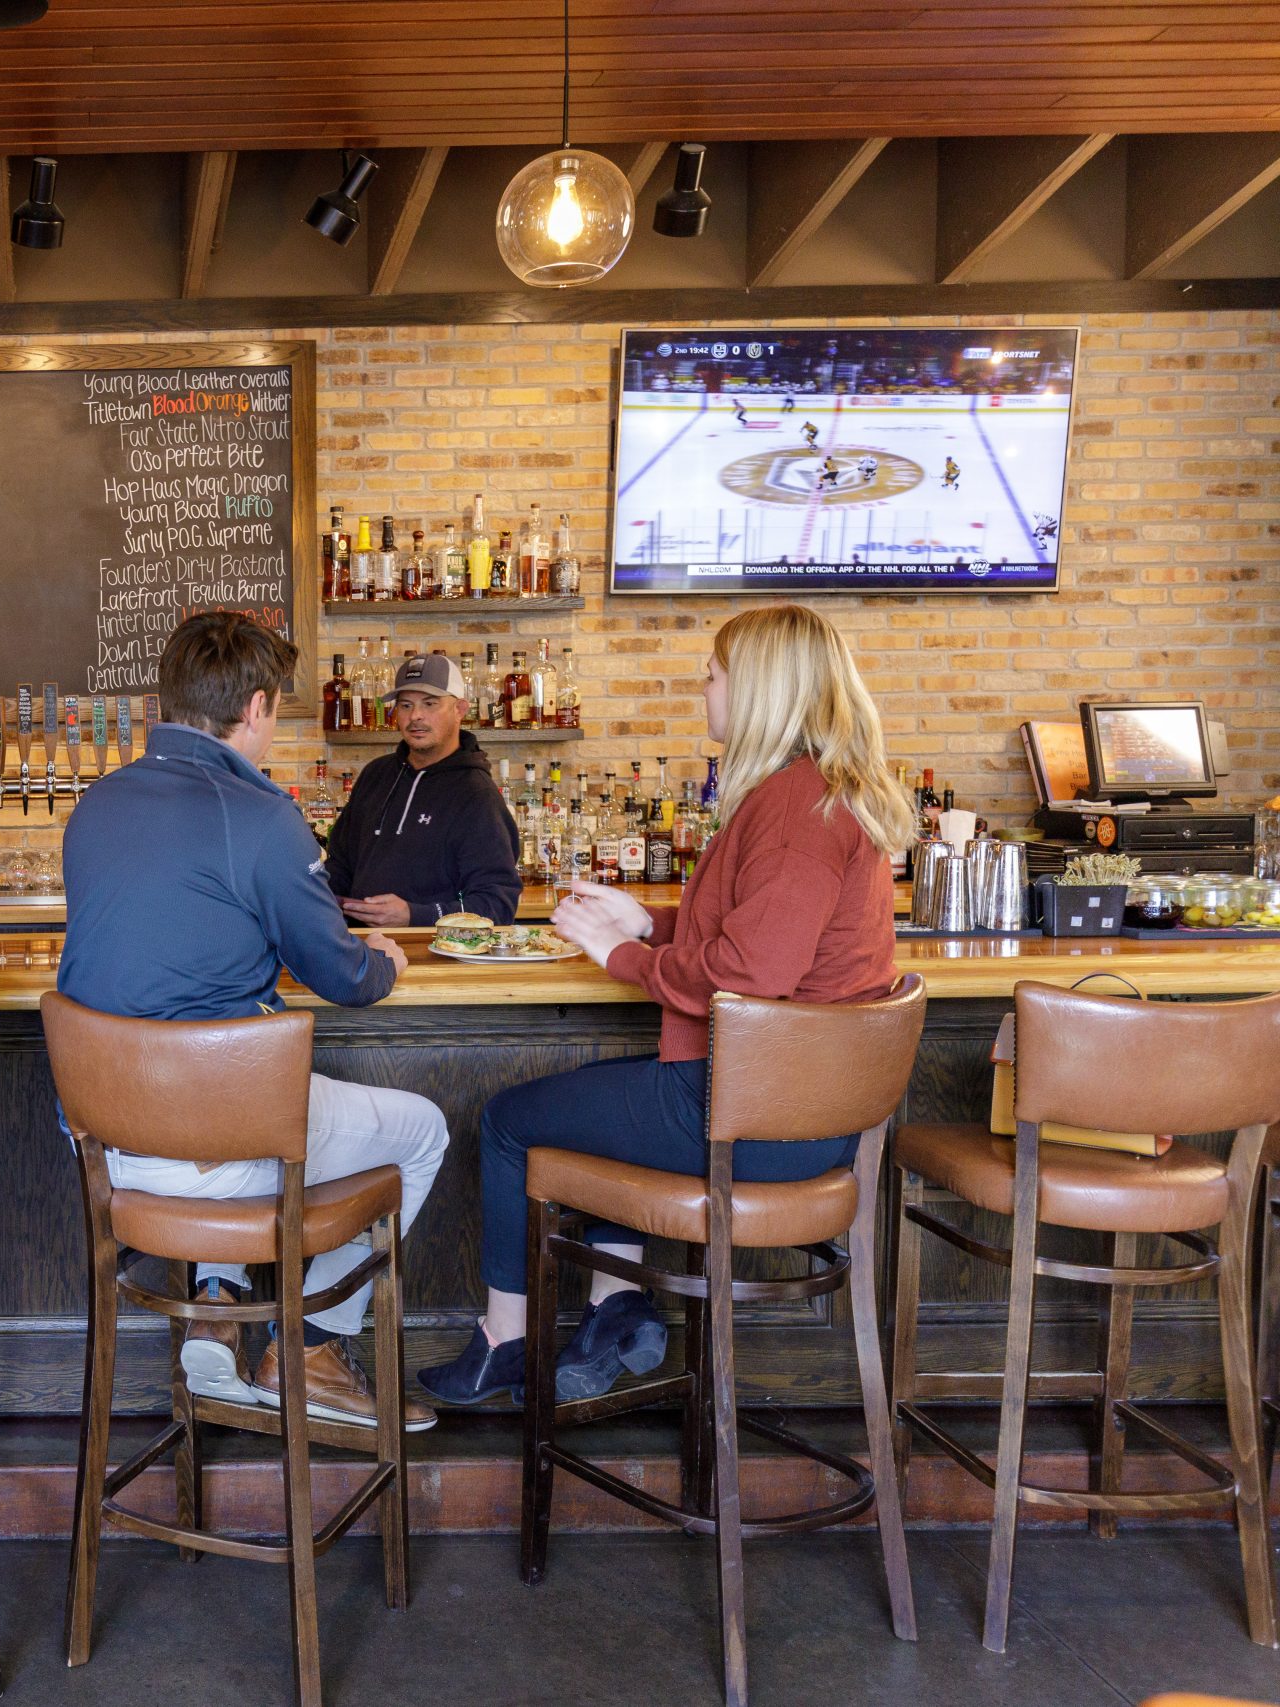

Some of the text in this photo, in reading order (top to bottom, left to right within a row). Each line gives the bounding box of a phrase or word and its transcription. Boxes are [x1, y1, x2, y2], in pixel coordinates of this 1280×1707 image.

[689, 346, 710, 355] 19:42
[732, 346, 740, 356] 0
[768, 345, 774, 355] 1
[83, 373, 133, 399] Young
[137, 370, 180, 395] Blood
[184, 371, 238, 391] Leather
[82, 390, 291, 425] Titletown Blood Orange Witbier
[120, 414, 291, 450] Fair State Nitro Stout
[227, 443, 264, 468] Bite
[104, 473, 288, 504] Hop Haus Magic Dragon
[120, 495, 273, 530] Young Blood Rufio
[123, 522, 273, 558] Surly P.O.G. Supreme
[853, 539, 982, 558] allegiant
[99, 550, 286, 588] Founders Dirty Bastard
[698, 566, 731, 574] NHL.COM
[745, 566, 788, 574] DOWNLOAD
[791, 566, 804, 574] THE
[806, 566, 837, 574] OFFICIAL
[839, 566, 854, 574] APP
[934, 565, 948, 573] THE
[100, 580, 284, 612] Lakefront Tequila Barrel
[96, 609, 178, 640] Hinterland
[98, 640, 142, 668] Down
[87, 662, 139, 693] Central
